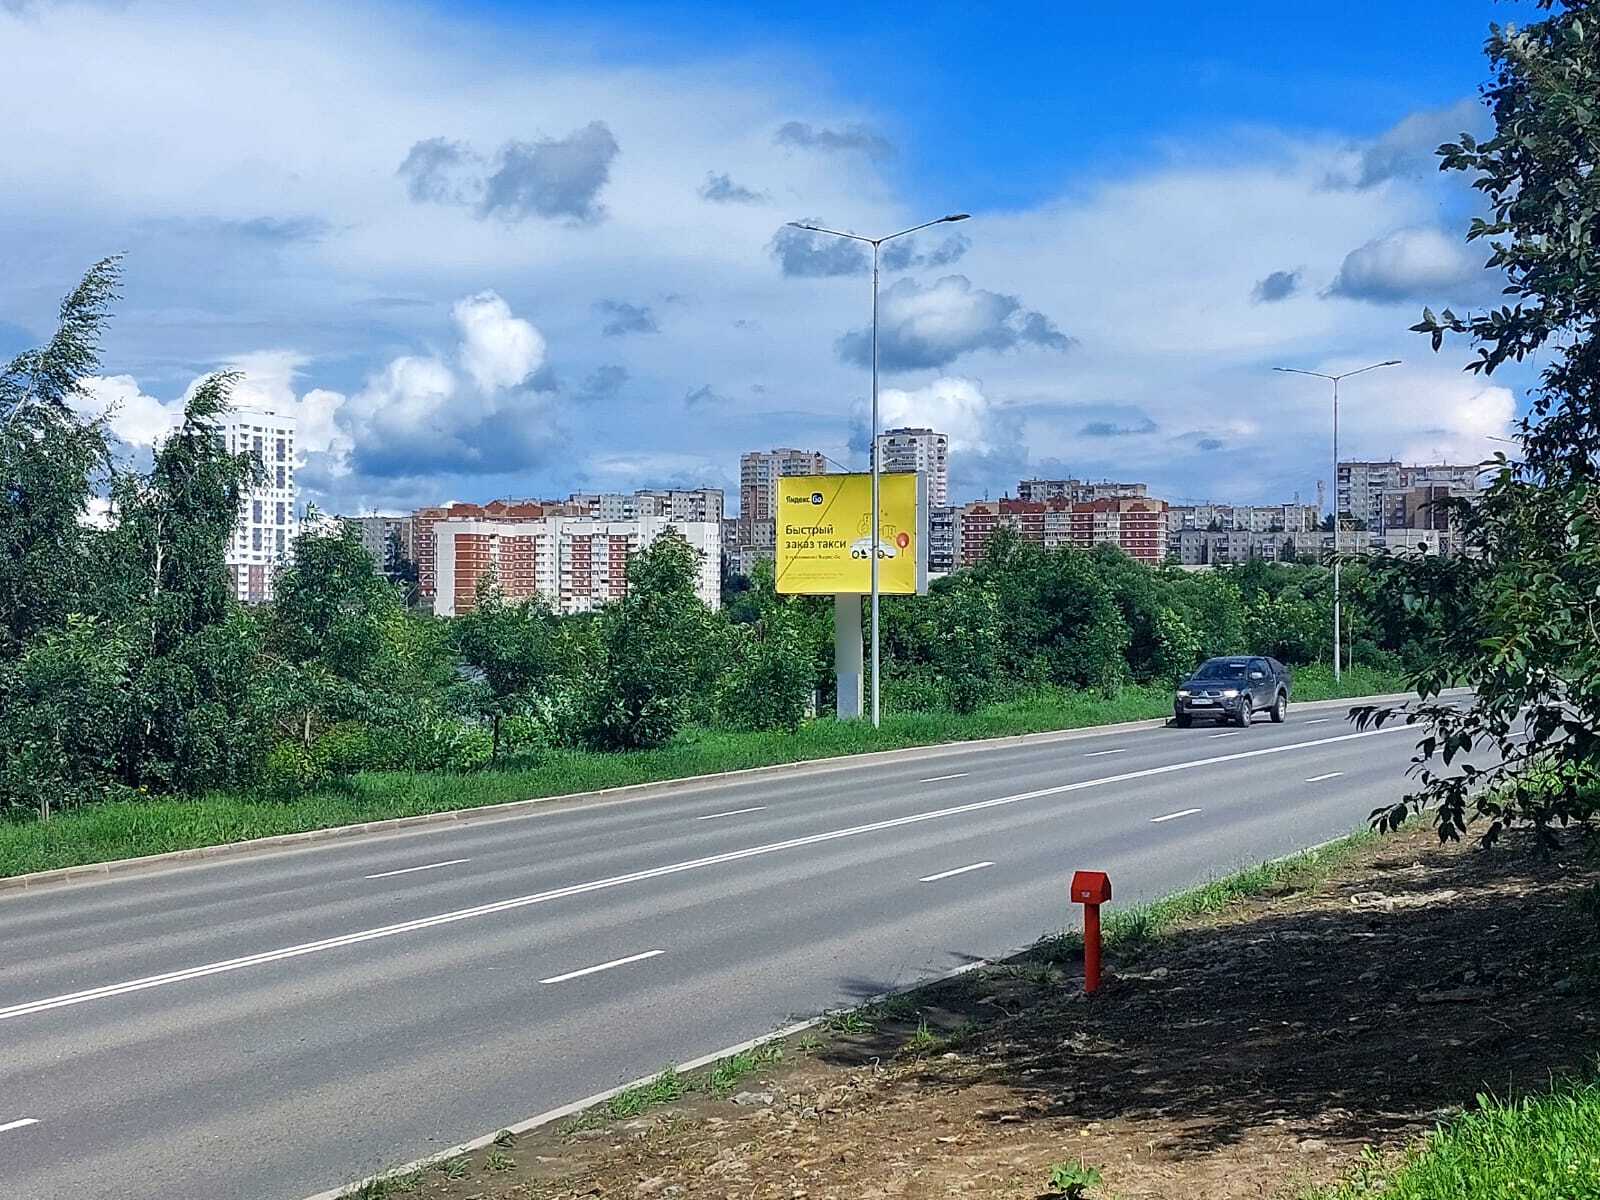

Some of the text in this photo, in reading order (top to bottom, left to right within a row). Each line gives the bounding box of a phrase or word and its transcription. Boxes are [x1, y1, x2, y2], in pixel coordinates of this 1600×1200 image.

[785, 524, 834, 537] Быстрый
[785, 540, 847, 549] заказ такси
